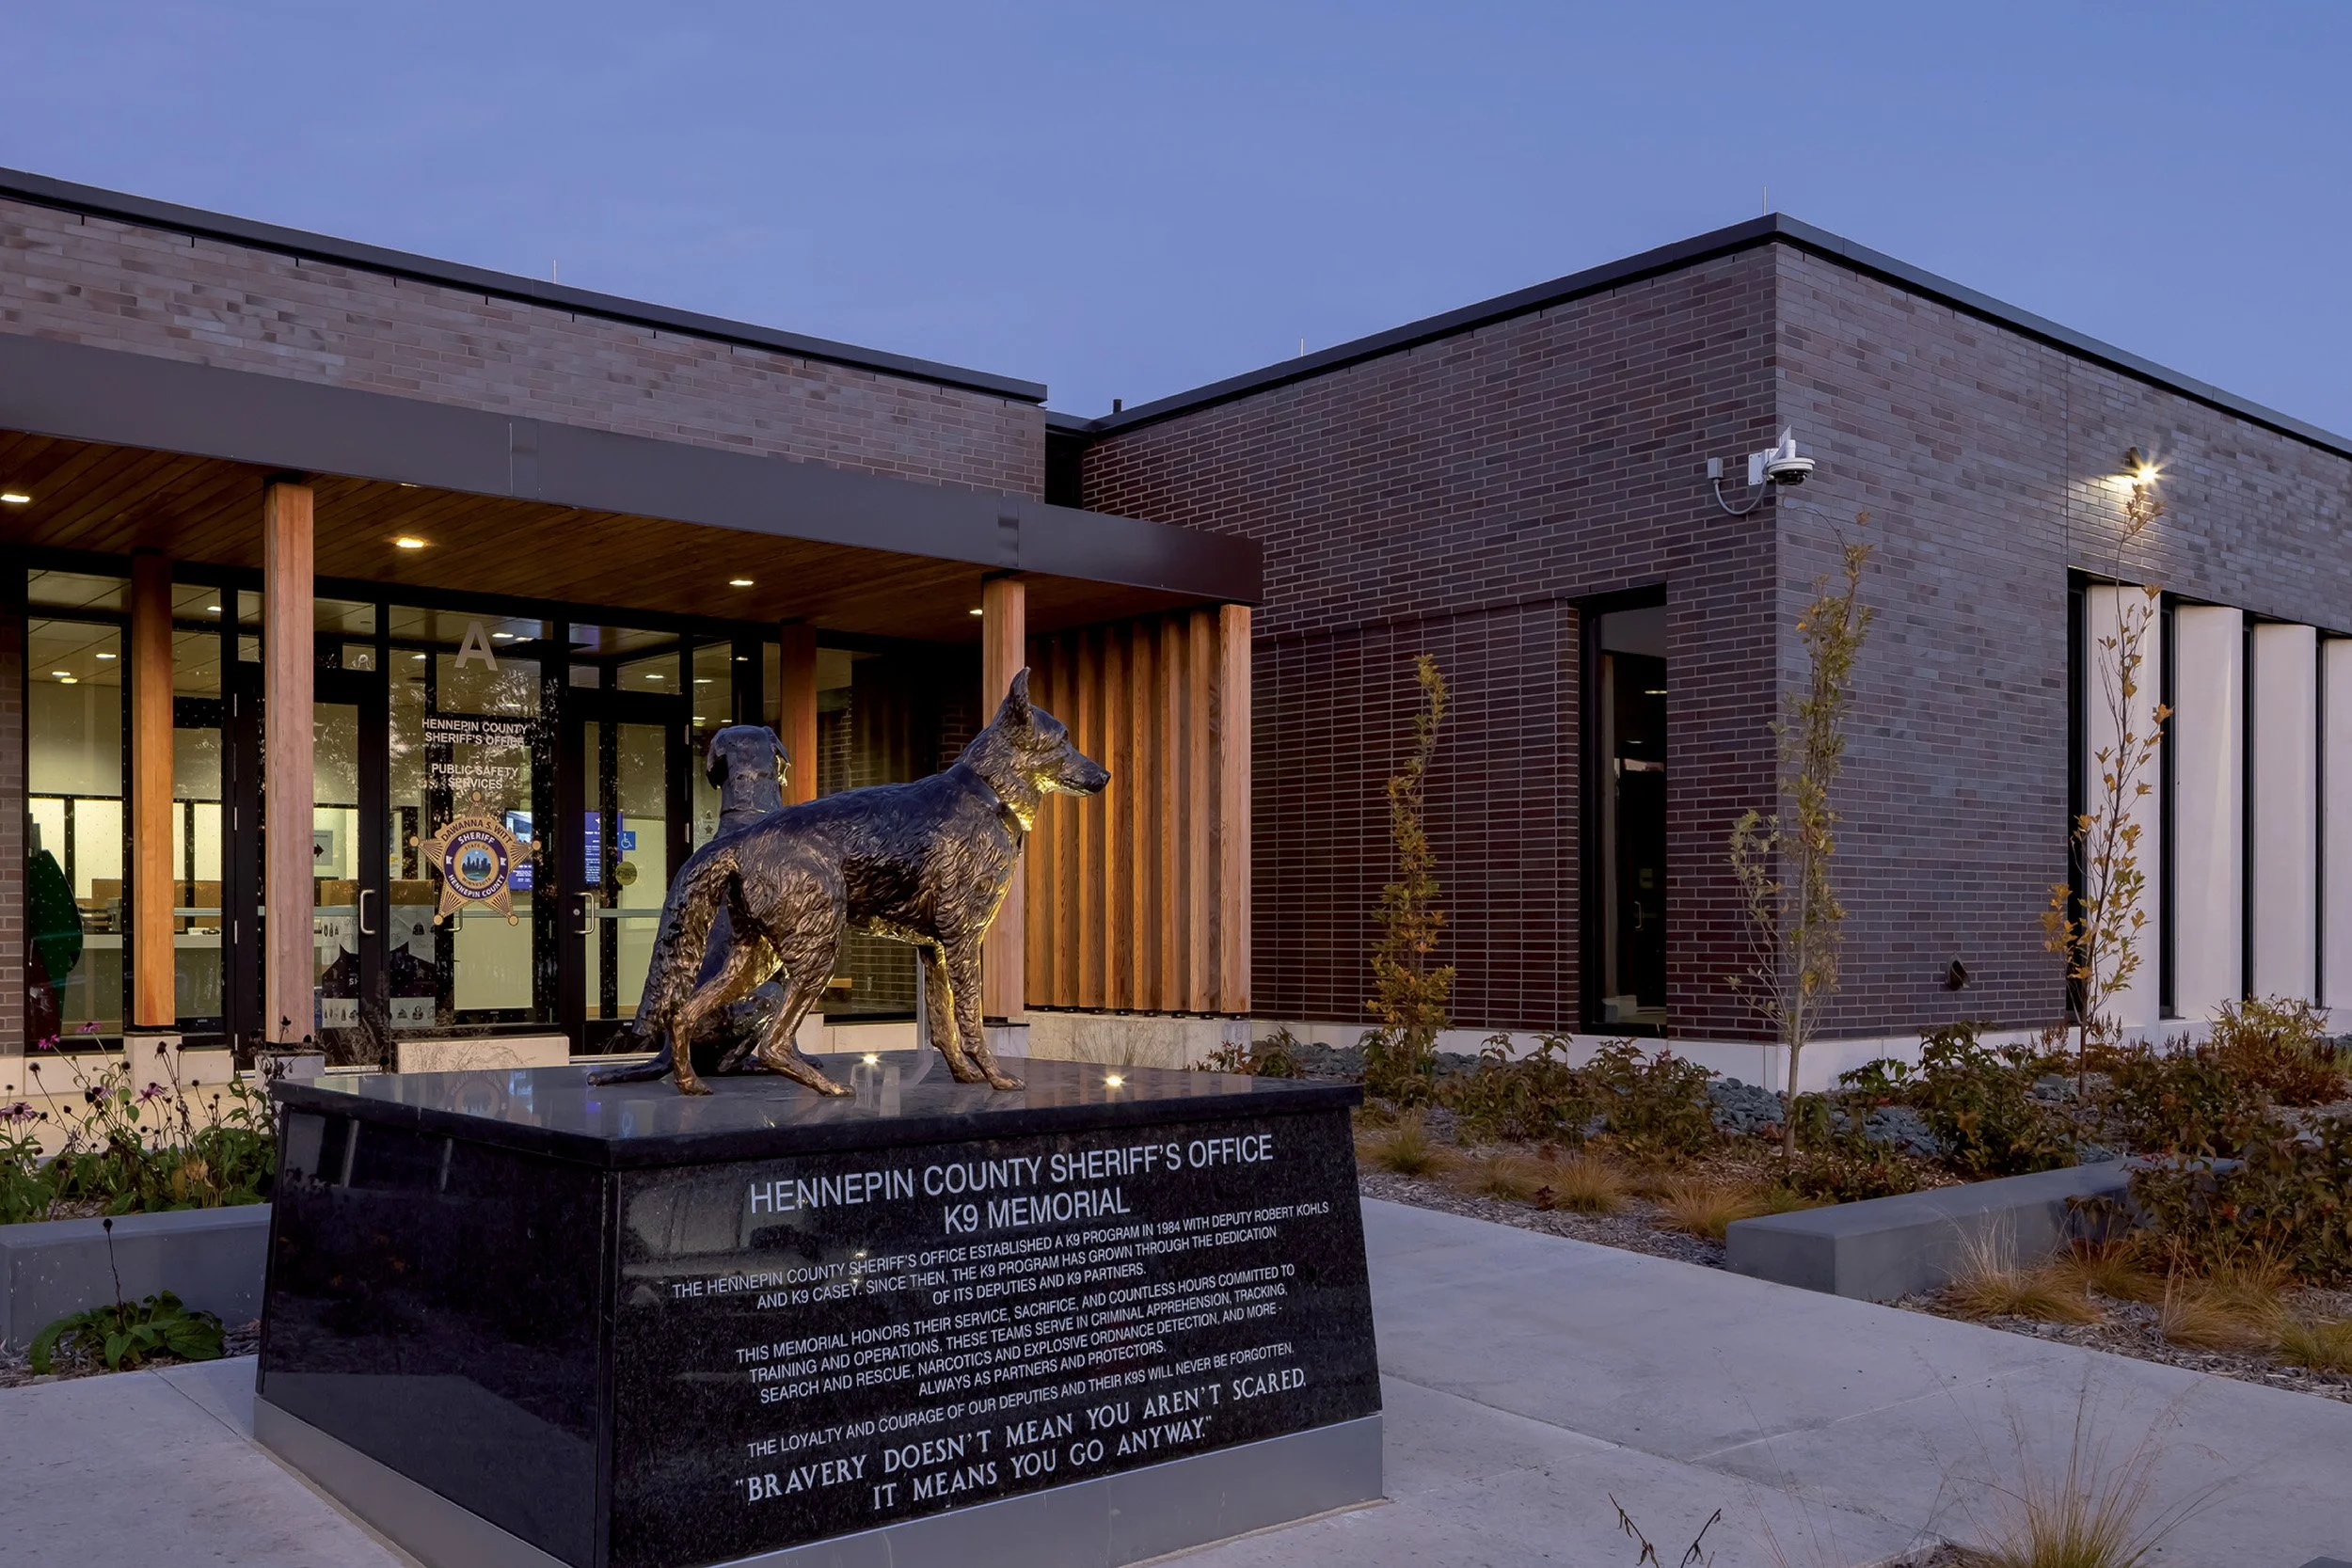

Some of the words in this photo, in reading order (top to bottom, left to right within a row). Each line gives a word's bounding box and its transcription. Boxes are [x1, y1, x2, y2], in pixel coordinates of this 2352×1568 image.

[454, 621, 499, 672] A
[421, 719, 479, 732] HENNEPIN
[482, 722, 528, 735] COUNTY
[425, 732, 483, 745] SHERIFF'S
[485, 735, 525, 747] OFFICE
[431, 764, 471, 774] PUBLIC
[475, 766, 518, 777] SAFETY
[448, 778, 503, 789] SERVICES
[441, 819, 484, 842] DAWANNA
[494, 825, 513, 844] WITT
[457, 832, 496, 845] SHERIFF
[448, 874, 481, 897] HENNEPIN
[482, 875, 505, 897] COUNTY
[751, 1168, 914, 1214] HENNEPIN
[923, 1155, 1042, 1196] COUNTY
[1050, 1142, 1182, 1183] SHERIFF'S
[1188, 1133, 1274, 1168] OFFICE
[944, 1203, 978, 1235] K9
[987, 1186, 1131, 1229] MEMORIAL
[672, 1280, 703, 1299] THE
[707, 1271, 783, 1295] HENNEPIN
[787, 1262, 846, 1284] COUNTY
[849, 1253, 917, 1275] SHERIFF'S
[919, 1246, 967, 1266] OFFICE
[969, 1236, 1053, 1260] ESTABLISHED
[1054, 1234, 1064, 1249] A
[1065, 1232, 1081, 1247] K9
[1082, 1225, 1140, 1245] PROGRAM
[1142, 1223, 1154, 1237] IN
[1156, 1220, 1181, 1235] 1984
[1182, 1215, 1210, 1231] WITH
[1211, 1211, 1253, 1228] DEPUTY
[1254, 1205, 1295, 1223] ROBERT
[1295, 1200, 1329, 1217] KOHLS
[756, 1291, 788, 1310] AND
[791, 1289, 809, 1305] K9
[812, 1279, 863, 1302] CASEY.
[866, 1275, 907, 1294] SINCE
[909, 1270, 949, 1288] THEN,
[951, 1265, 977, 1282] THE
[979, 1263, 995, 1279] K9
[998, 1254, 1059, 1275] PROGRAM
[1061, 1251, 1087, 1267] HAS
[1088, 1244, 1133, 1263] GROWN
[1135, 1237, 1190, 1257] THROUGH
[1191, 1233, 1214, 1249] THE
[1215, 1226, 1277, 1246] DEDICATION
[932, 1289, 951, 1306] OF
[953, 1286, 974, 1303] ITS
[976, 1277, 1037, 1299] DEPUTIES
[1039, 1274, 1065, 1290] AND
[1067, 1271, 1082, 1286] K9
[1084, 1262, 1147, 1283] PARTNERS.
[735, 1344, 770, 1364] THIS
[772, 1333, 849, 1358] MEMORIAL
[850, 1323, 911, 1346] HONORS
[913, 1316, 952, 1336] THEIR
[954, 1307, 1011, 1329] SERVICE,
[1013, 1296, 1079, 1320] SACRIFICE,
[1081, 1292, 1106, 1309] AND
[1108, 1281, 1176, 1305] COUNTLESS
[1177, 1275, 1216, 1293] HOURS
[1217, 1266, 1279, 1288] COMMITTED
[1279, 1263, 1295, 1277] TO
[749, 1358, 818, 1384] TRAINING
[820, 1354, 850, 1372] AND
[853, 1338, 943, 1367] OPERATIONS.
[946, 1330, 988, 1351] THESE
[990, 1323, 1033, 1343] TEAMS
[1035, 1316, 1074, 1337] SERVE
[1076, 1314, 1089, 1329] IN
[1090, 1306, 1145, 1327] CRIMINAL
[1146, 1291, 1232, 1318] APPREHENSION,
[1233, 1283, 1288, 1303] TRACKING,
[760, 1380, 819, 1404] SEARCH
[822, 1374, 853, 1393] AND
[856, 1364, 914, 1387] RESCUE,
[917, 1351, 993, 1377] NARCOTICS
[994, 1346, 1022, 1363] AND
[1024, 1334, 1089, 1358] EXPLOSIVE
[1089, 1323, 1154, 1346] ORDNANCE
[1156, 1312, 1220, 1335] DETECTION,
[1222, 1308, 1245, 1323] AND
[1247, 1303, 1277, 1319] MORE
[918, 1374, 972, 1397] ALWAYS
[974, 1370, 992, 1387] AS
[993, 1358, 1058, 1383] PARTNERS
[1059, 1354, 1086, 1371] AND
[1088, 1340, 1167, 1366] PROTECTORS.
[746, 1438, 777, 1458] THE
[780, 1426, 843, 1452] LOYALTY
[846, 1420, 876, 1440] AND
[878, 1406, 945, 1433] COURAGE
[946, 1402, 965, 1419] OF
[968, 1397, 997, 1416] OUR
[998, 1386, 1059, 1410] DEPUTIES
[1060, 1380, 1087, 1399] AND
[1088, 1373, 1122, 1392] THEIR
[1123, 1369, 1146, 1386] K9S
[1147, 1364, 1174, 1381] WILL
[1175, 1356, 1212, 1376] NEVER
[1213, 1353, 1228, 1369] BE
[1230, 1341, 1295, 1366] FORGOTTEN.
[883, 1430, 992, 1473] DOESN'T
[1006, 1413, 1073, 1449] MEAN
[1086, 1402, 1130, 1431] YOU
[1142, 1384, 1221, 1419] AREN'T
[1232, 1368, 1307, 1401] SCARED.
[873, 1481, 898, 1511] IT
[913, 1461, 998, 1502] MEANS
[1009, 1448, 1057, 1479] YOU
[1069, 1438, 1104, 1466] GO
